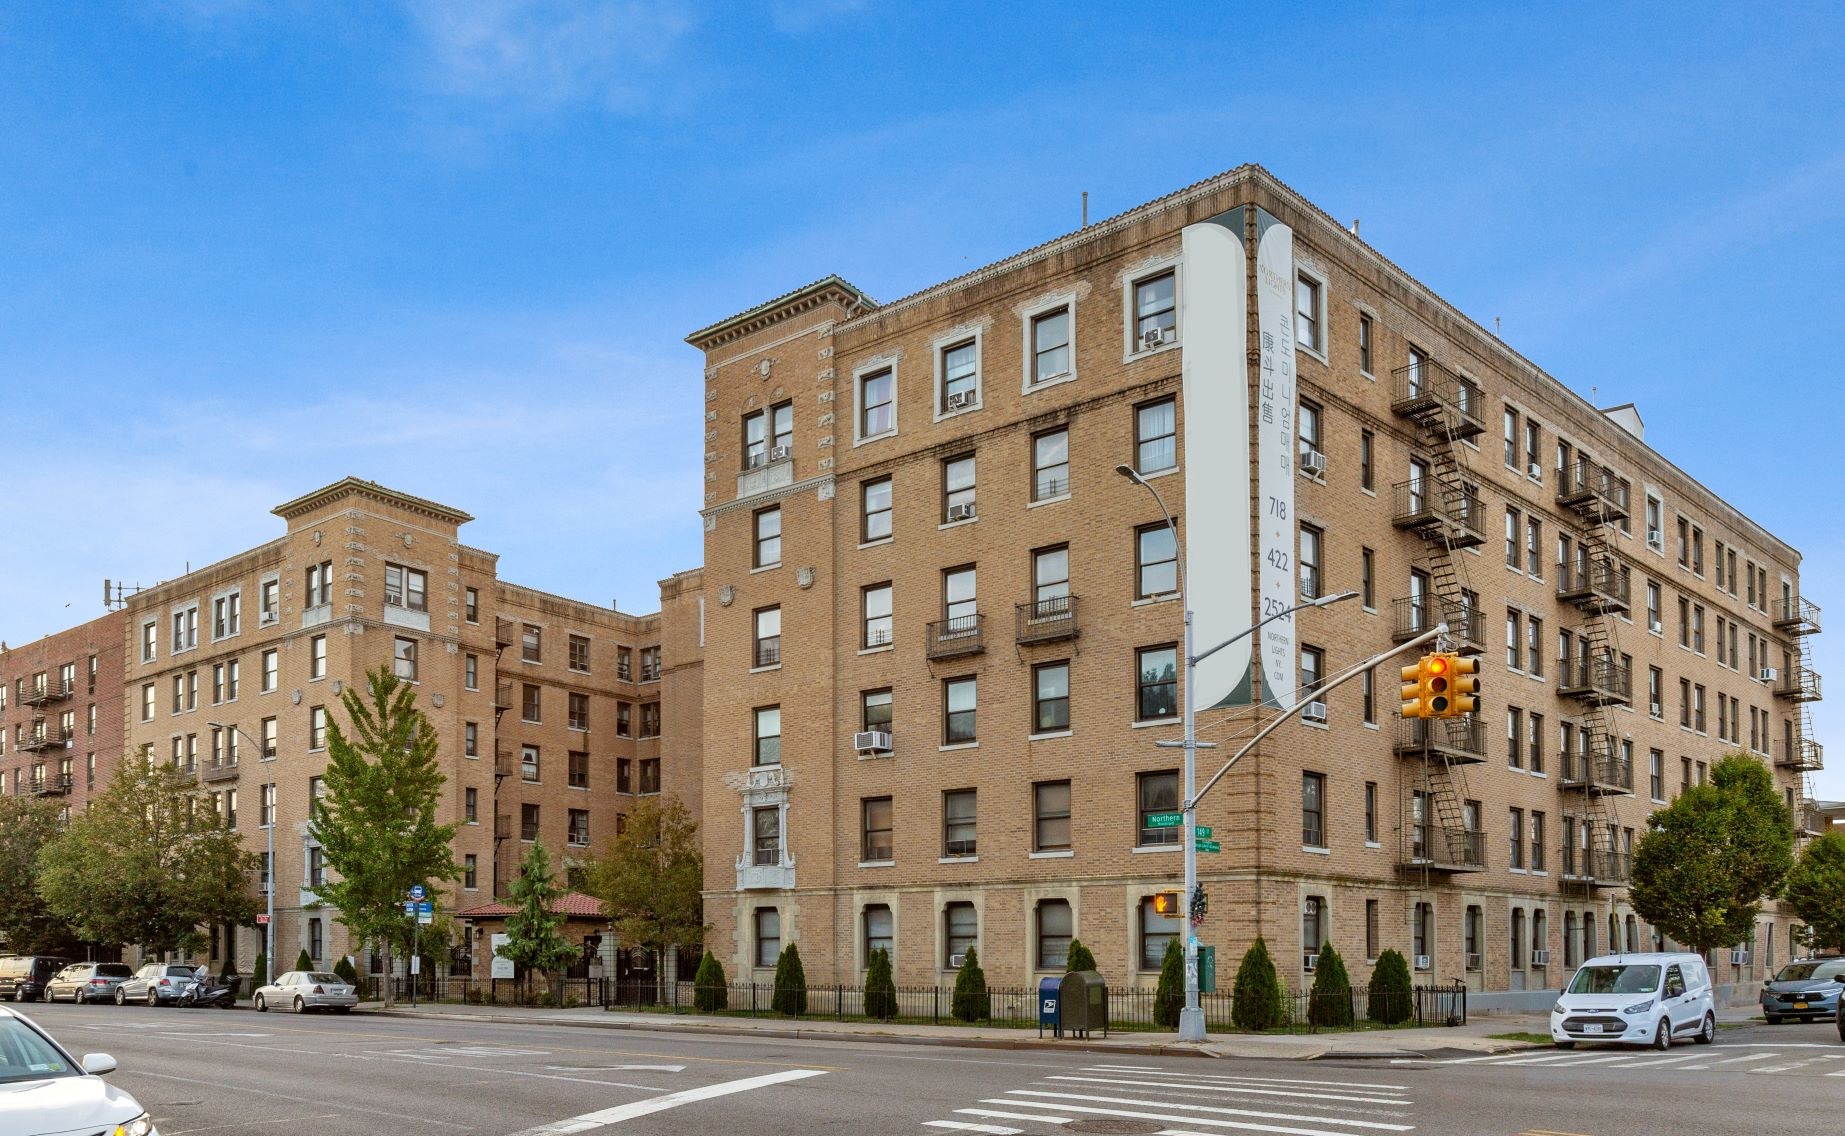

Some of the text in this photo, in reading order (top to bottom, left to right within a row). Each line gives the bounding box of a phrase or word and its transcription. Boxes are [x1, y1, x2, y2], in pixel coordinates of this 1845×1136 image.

[1269, 496, 1287, 520] 718
[1267, 548, 1288, 572] 422
[1264, 596, 1292, 623] 2524
[1152, 815, 1180, 823] Northern
[1197, 827, 1205, 837] 149
